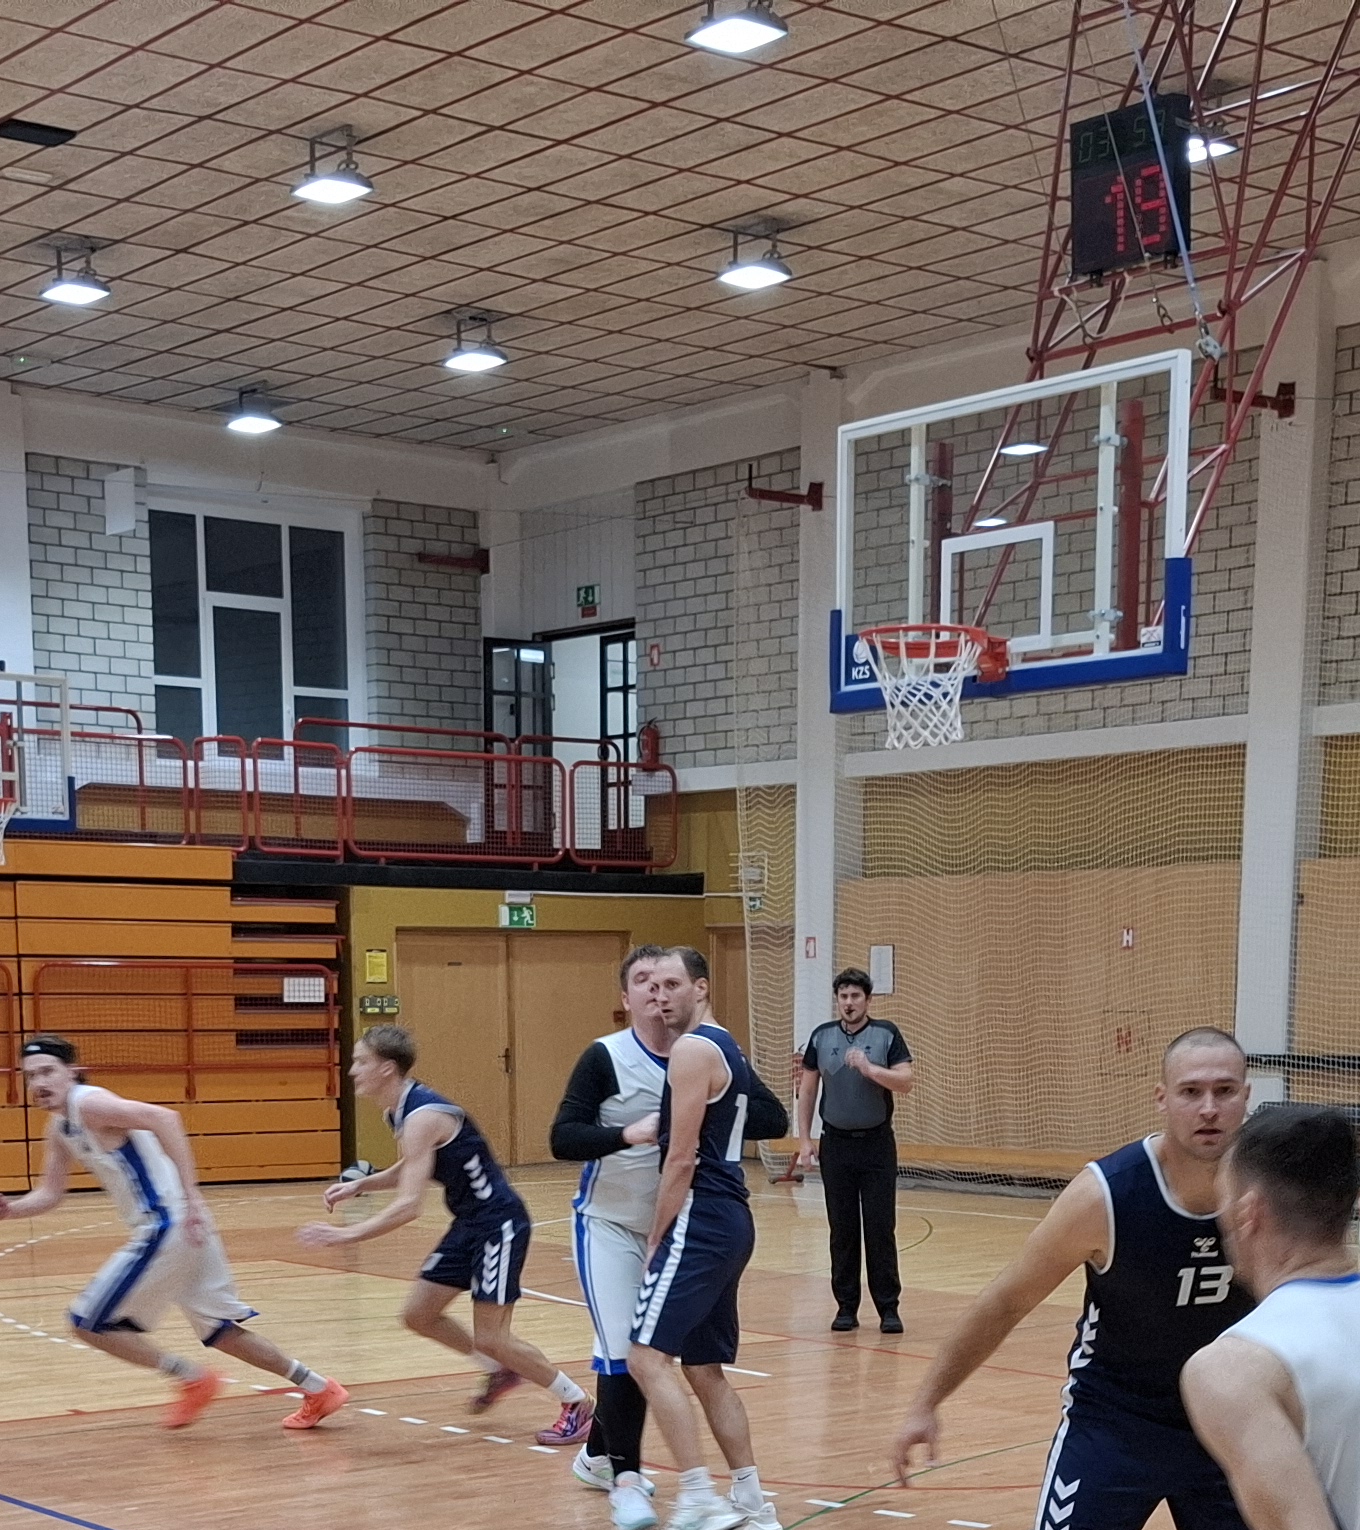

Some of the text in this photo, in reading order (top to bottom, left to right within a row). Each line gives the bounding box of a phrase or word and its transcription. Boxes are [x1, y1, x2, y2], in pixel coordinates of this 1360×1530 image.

[1104, 164, 1168, 253] 19
[851, 665, 870, 680] KZS
[725, 1093, 749, 1161] 1
[1175, 1265, 1234, 1307] 13
